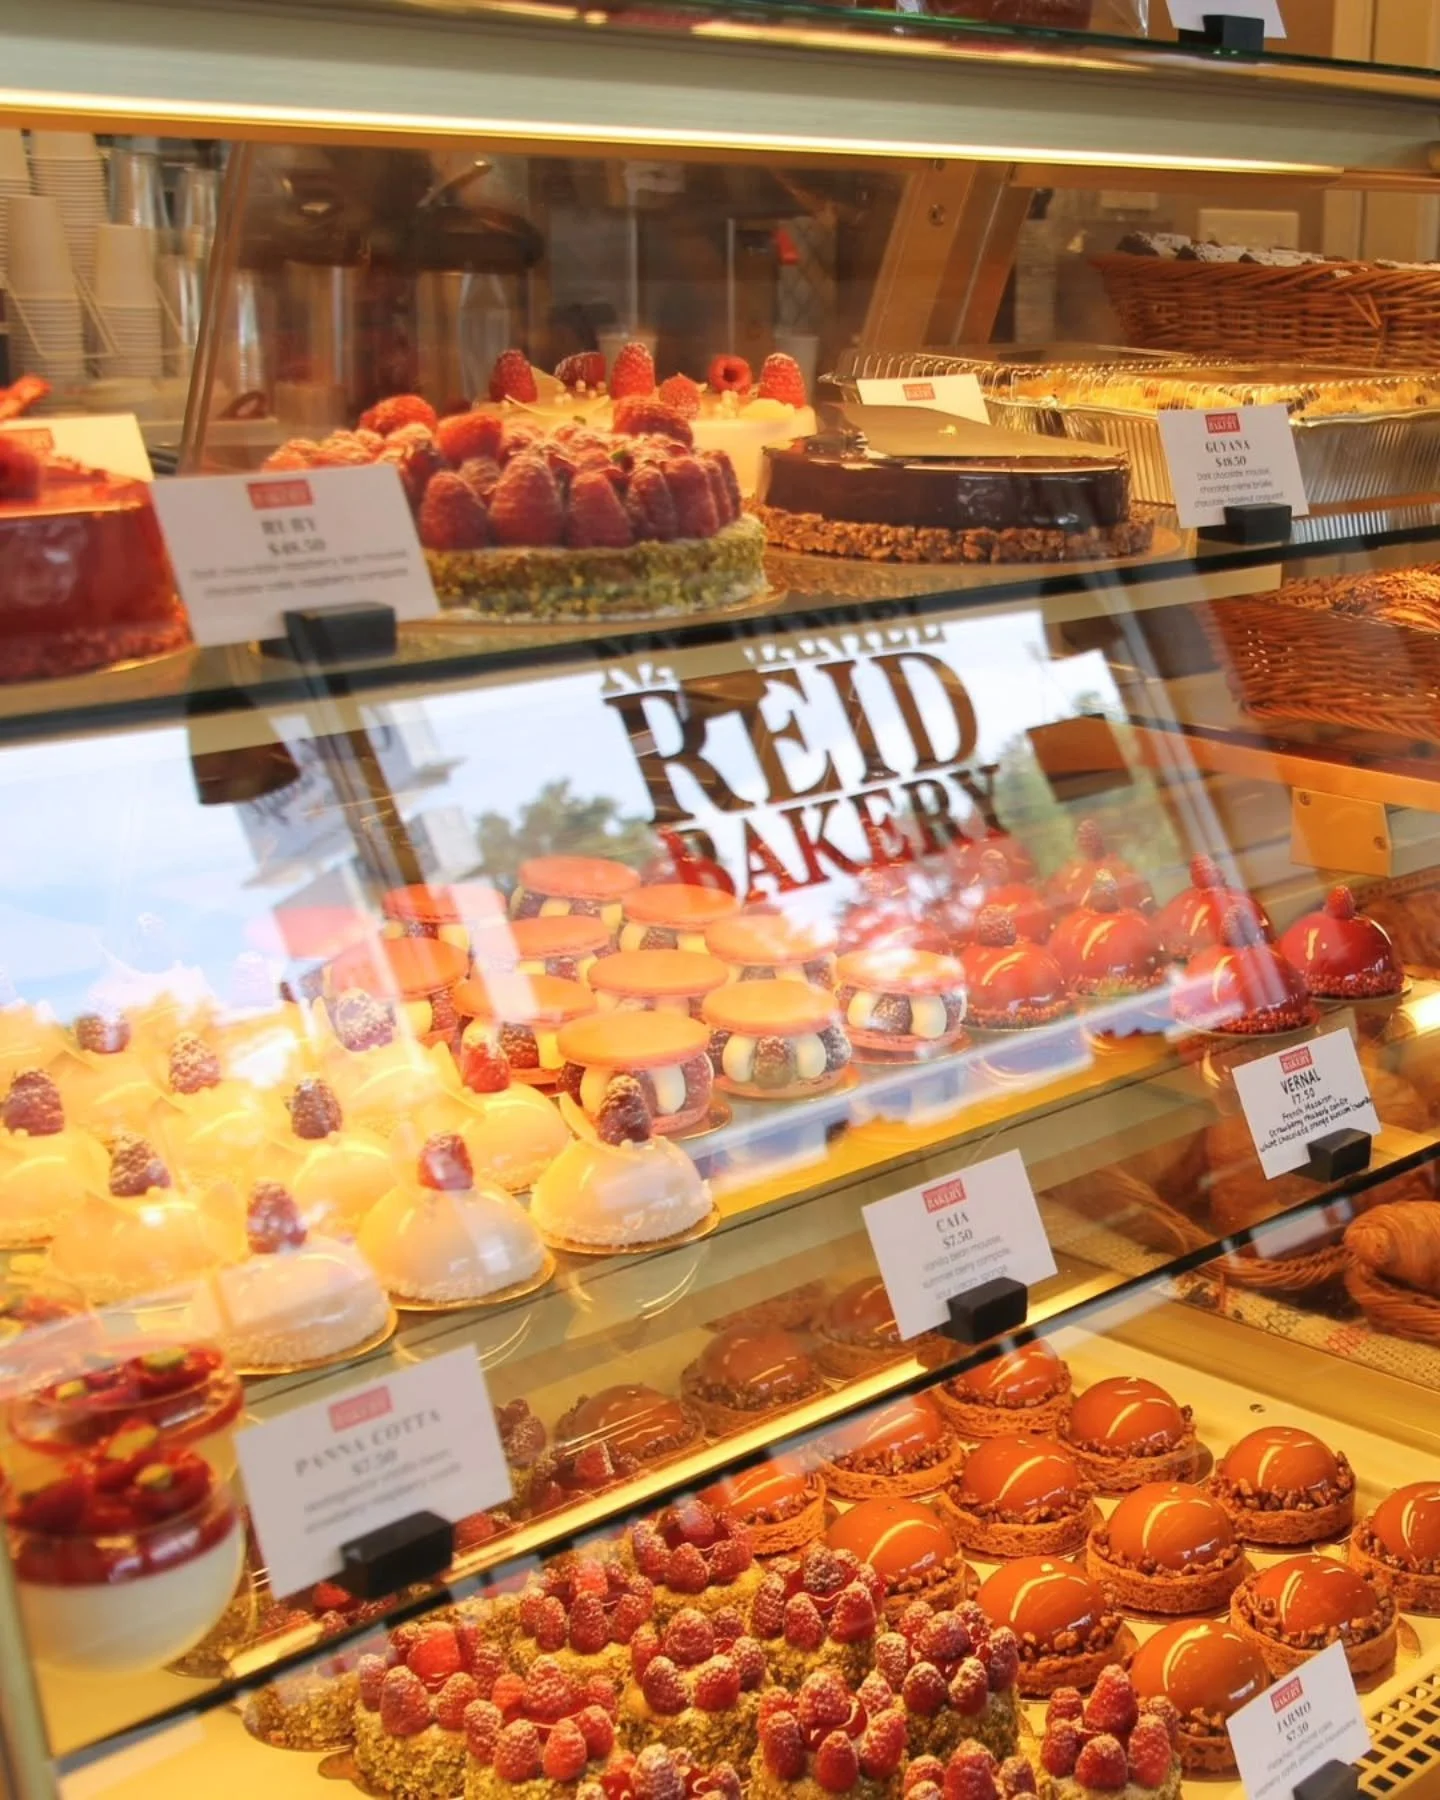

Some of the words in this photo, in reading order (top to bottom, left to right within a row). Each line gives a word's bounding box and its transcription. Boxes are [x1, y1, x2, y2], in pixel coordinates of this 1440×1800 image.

[1204, 440, 1251, 453] GUYANA
[1214, 469, 1243, 480] chocolate
[603, 650, 980, 823] REID
[656, 763, 1011, 904] BAKERY
[1280, 1068, 1322, 1095] VERNAL
[942, 1228, 974, 1250] $7.50
[294, 1434, 369, 1477] PANNA
[371, 1408, 442, 1447] COTTA
[1275, 1701, 1312, 1735] JARMO
